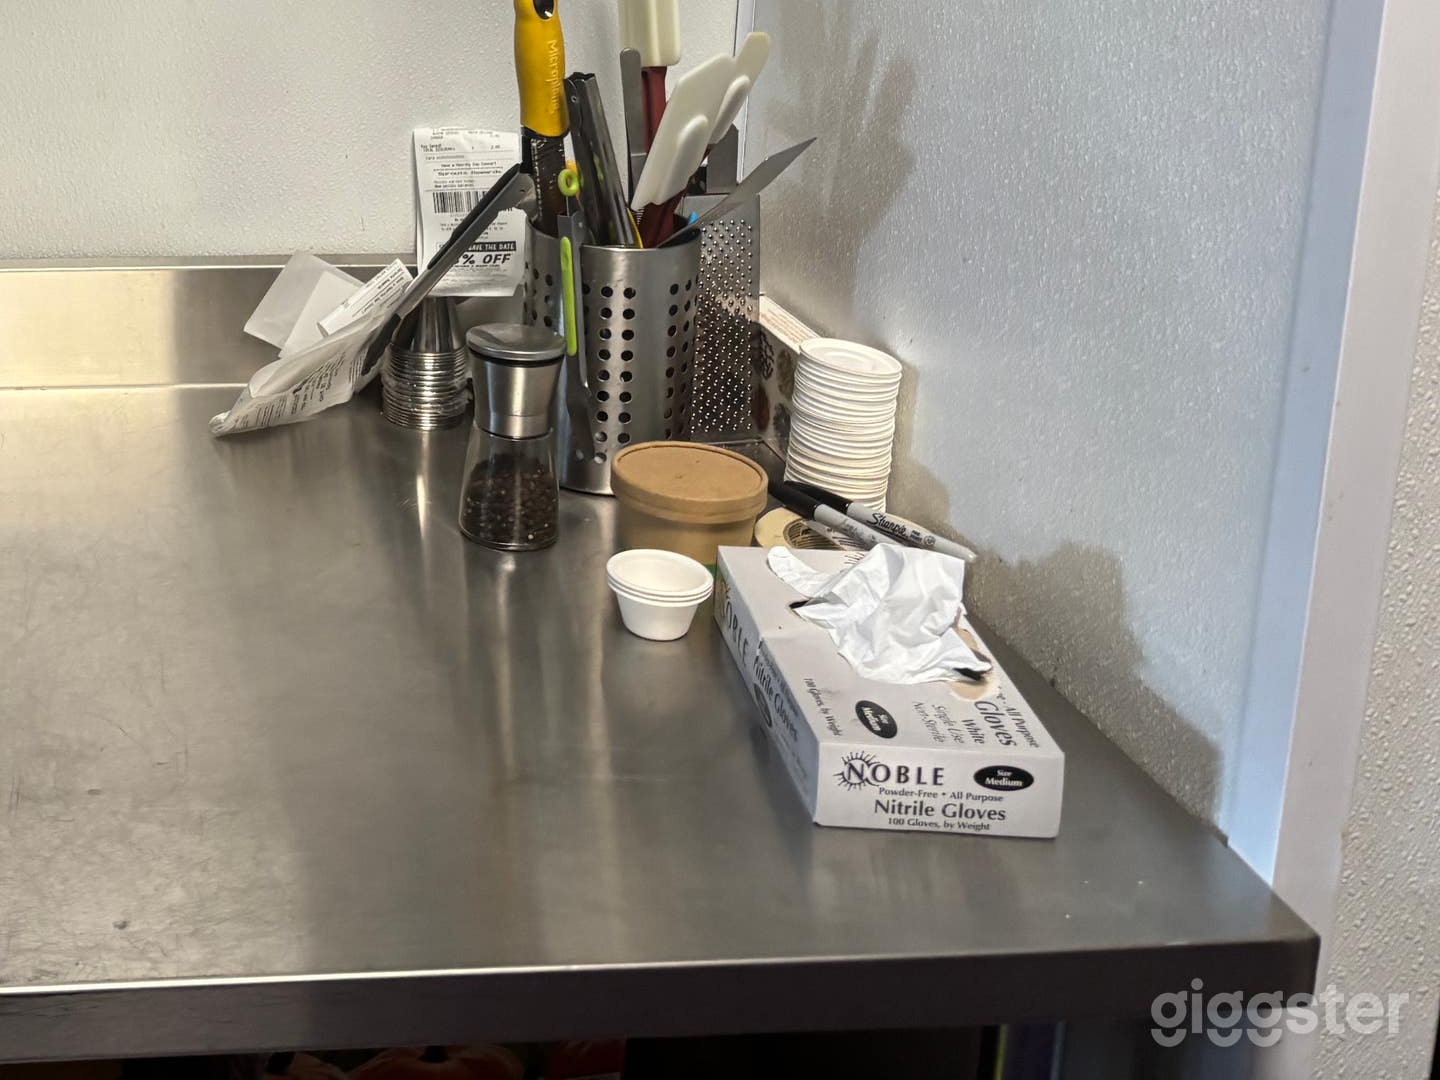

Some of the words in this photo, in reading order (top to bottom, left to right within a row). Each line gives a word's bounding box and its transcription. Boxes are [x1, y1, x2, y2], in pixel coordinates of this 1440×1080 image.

[485, 242, 496, 250] THE
[498, 242, 515, 250] DATE
[483, 253, 511, 264] OFF
[962, 719, 985, 744] White
[974, 700, 1017, 747] Gloves
[1015, 716, 1040, 748] Purpose
[847, 762, 945, 786] NOBLE
[996, 769, 1013, 777] Size
[984, 776, 1023, 787] Medium
[879, 787, 939, 799] Powder-Free
[949, 792, 964, 801] All
[966, 793, 1004, 803] Purpose
[874, 799, 935, 817] Nitrile
[941, 802, 1007, 821] Gloves
[887, 817, 905, 826] 100
[907, 818, 940, 829] Gloves,
[943, 819, 955, 830] by
[958, 821, 991, 832] Weight
